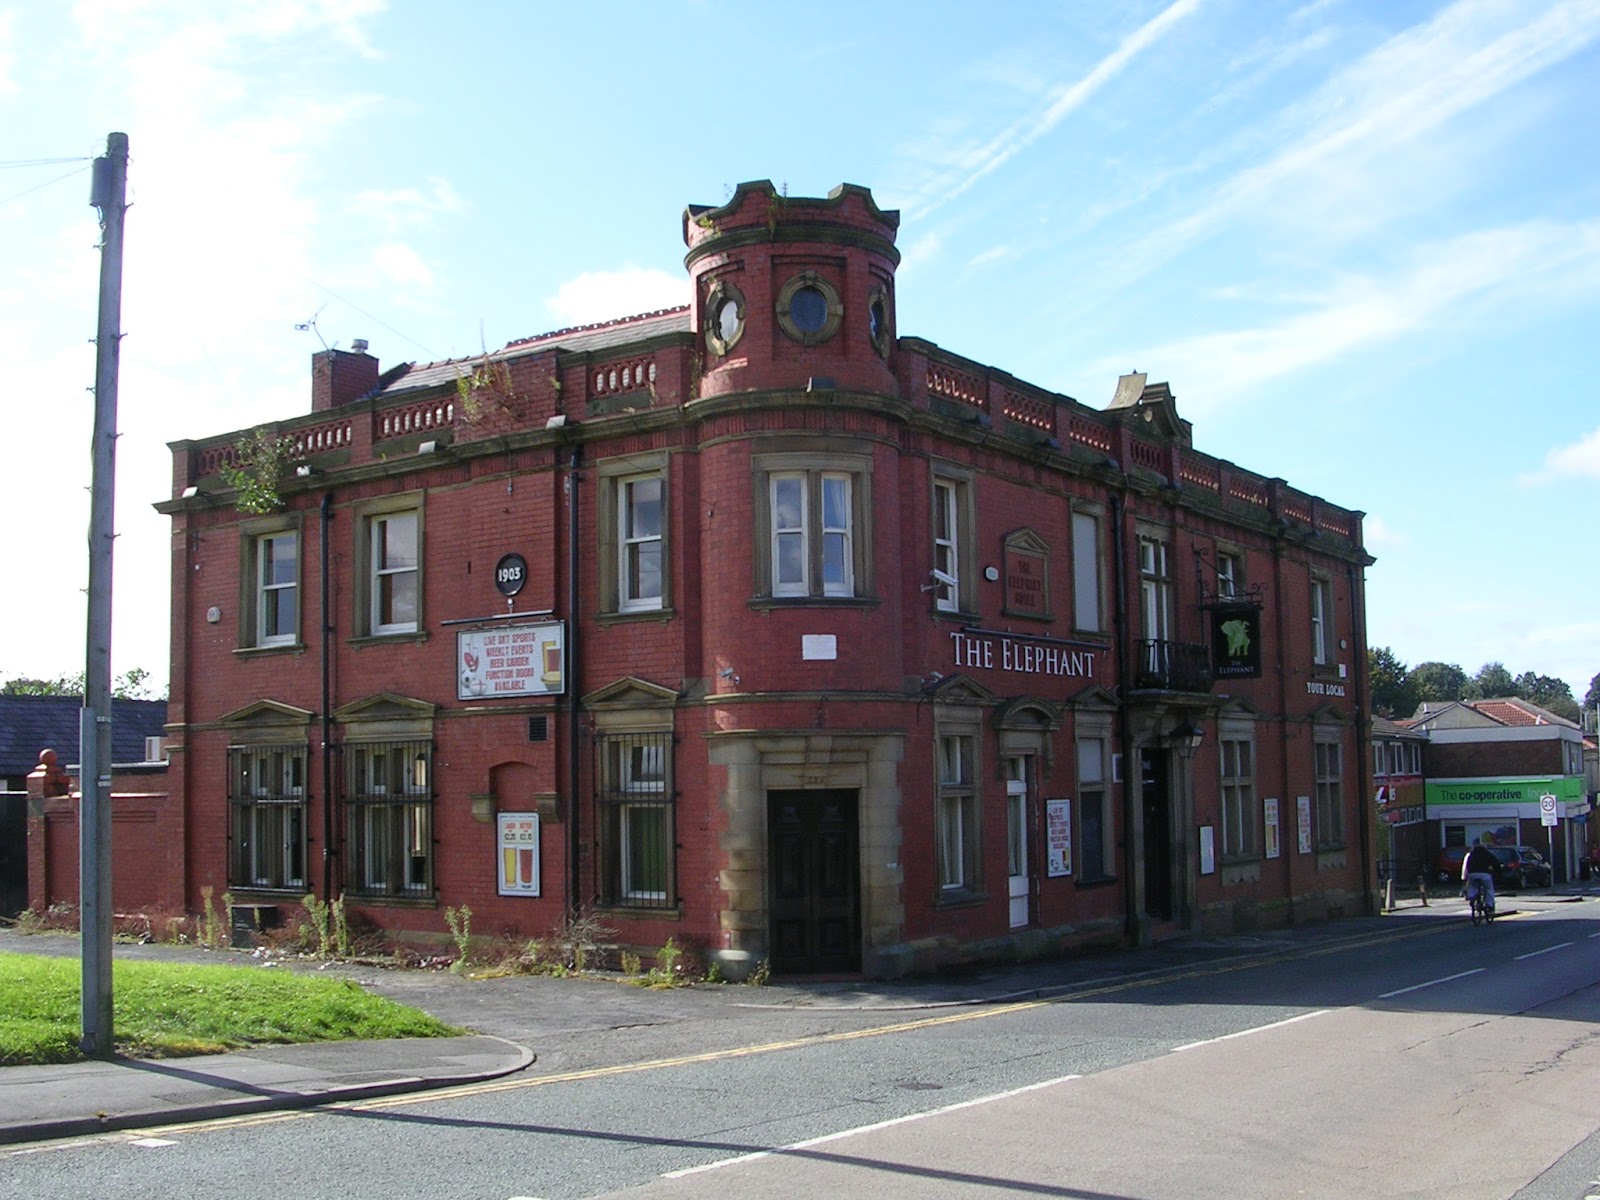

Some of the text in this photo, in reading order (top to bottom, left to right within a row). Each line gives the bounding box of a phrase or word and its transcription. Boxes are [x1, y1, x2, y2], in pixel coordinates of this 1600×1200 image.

[498, 567, 520, 582] 1903
[484, 632, 536, 646] LIVE SKY SPORTS
[486, 644, 533, 657] WEEKLY EVENTS
[490, 656, 530, 668] BEER GARDEN
[486, 667, 535, 680] FUNCTION ROOM
[494, 680, 526, 691] AVAILABLE
[1306, 681, 1345, 696] YOUR LOCAL
[1441, 789, 1458, 801] The
[1459, 788, 1522, 802] co-operative
